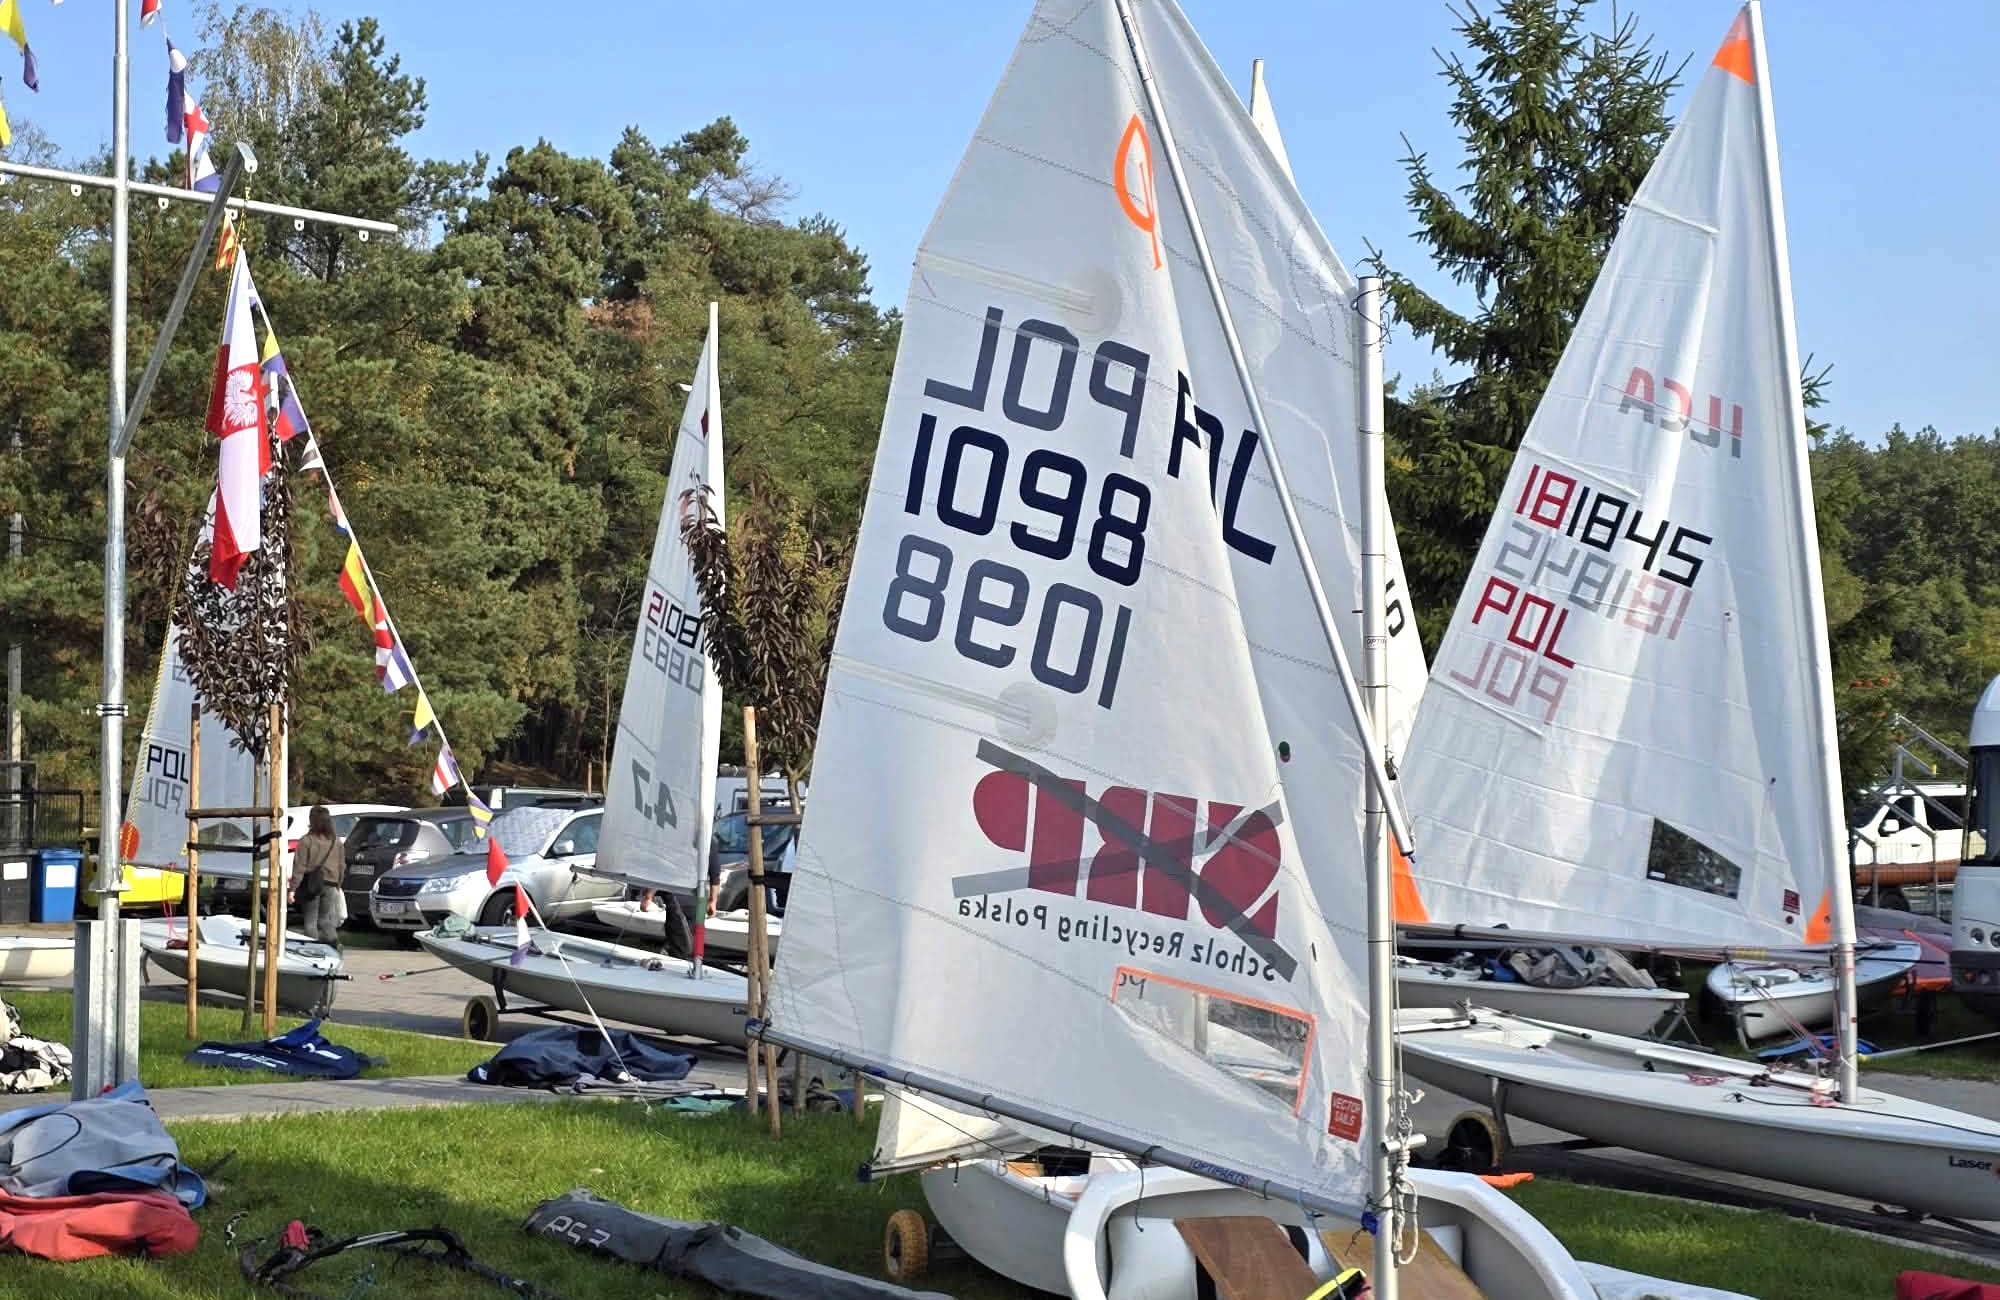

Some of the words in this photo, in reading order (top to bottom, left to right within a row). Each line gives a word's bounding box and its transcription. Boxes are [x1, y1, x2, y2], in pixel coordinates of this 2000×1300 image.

[904, 412, 1152, 587] 1098
[1516, 463, 1713, 588] 181845
[1471, 575, 1576, 670] POL
[146, 743, 189, 784] POL
[1949, 1155, 1992, 1170] Laser
